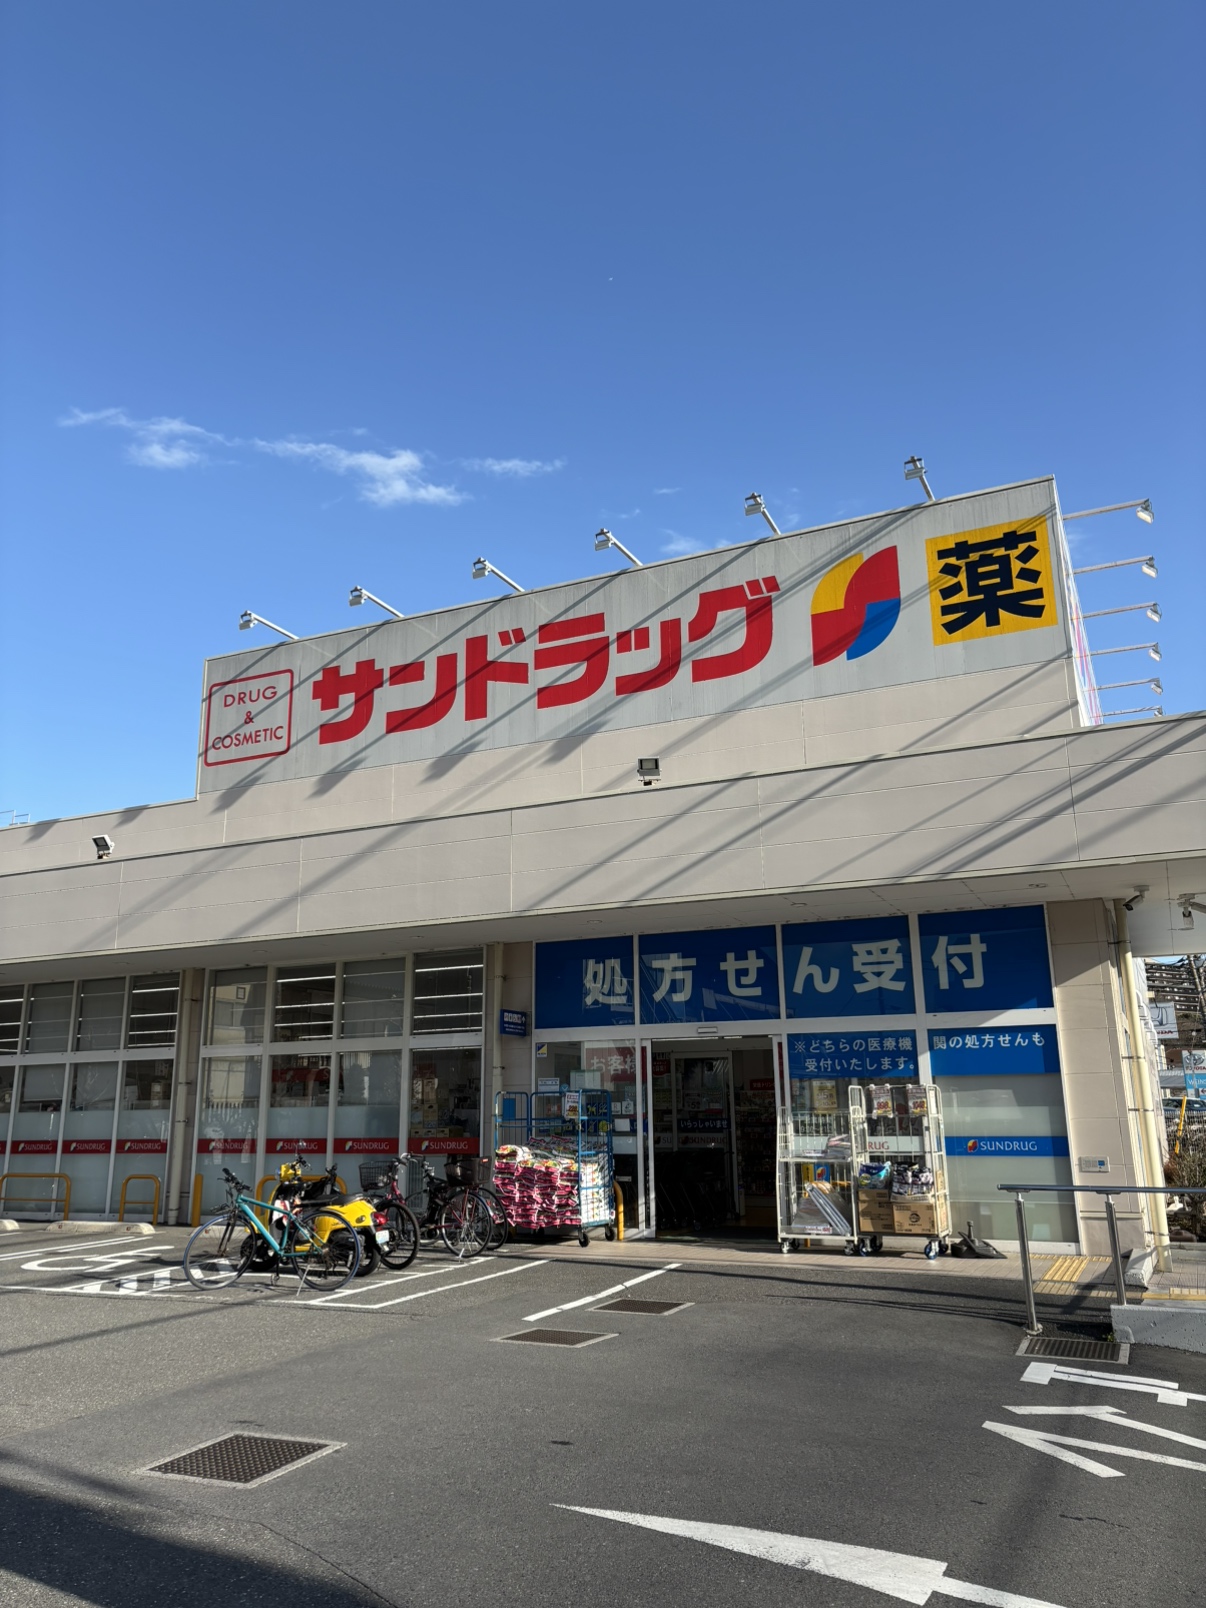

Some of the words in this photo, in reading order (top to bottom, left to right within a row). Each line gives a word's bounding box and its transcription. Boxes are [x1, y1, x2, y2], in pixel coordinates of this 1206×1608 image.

[936, 530, 1046, 636] 薬
[312, 575, 780, 745] サンドラッグ
[223, 686, 278, 708] DRUG
[243, 710, 255, 725] &
[211, 725, 284, 751] COSMETIC
[583, 933, 987, 1007] 処方せん受付
[804, 1057, 915, 1073] 受付いたします。
[680, 1119, 728, 1129] いらっしゃいませ
[24, 1142, 53, 1151] SUNDRUG
[76, 1142, 106, 1151] SUNDRUG
[131, 1142, 162, 1150] SUNDRUG
[353, 1141, 390, 1150] SUNDRUG
[430, 1140, 469, 1150] SUNDRUG
[979, 1140, 1038, 1152] SUNDRUG
